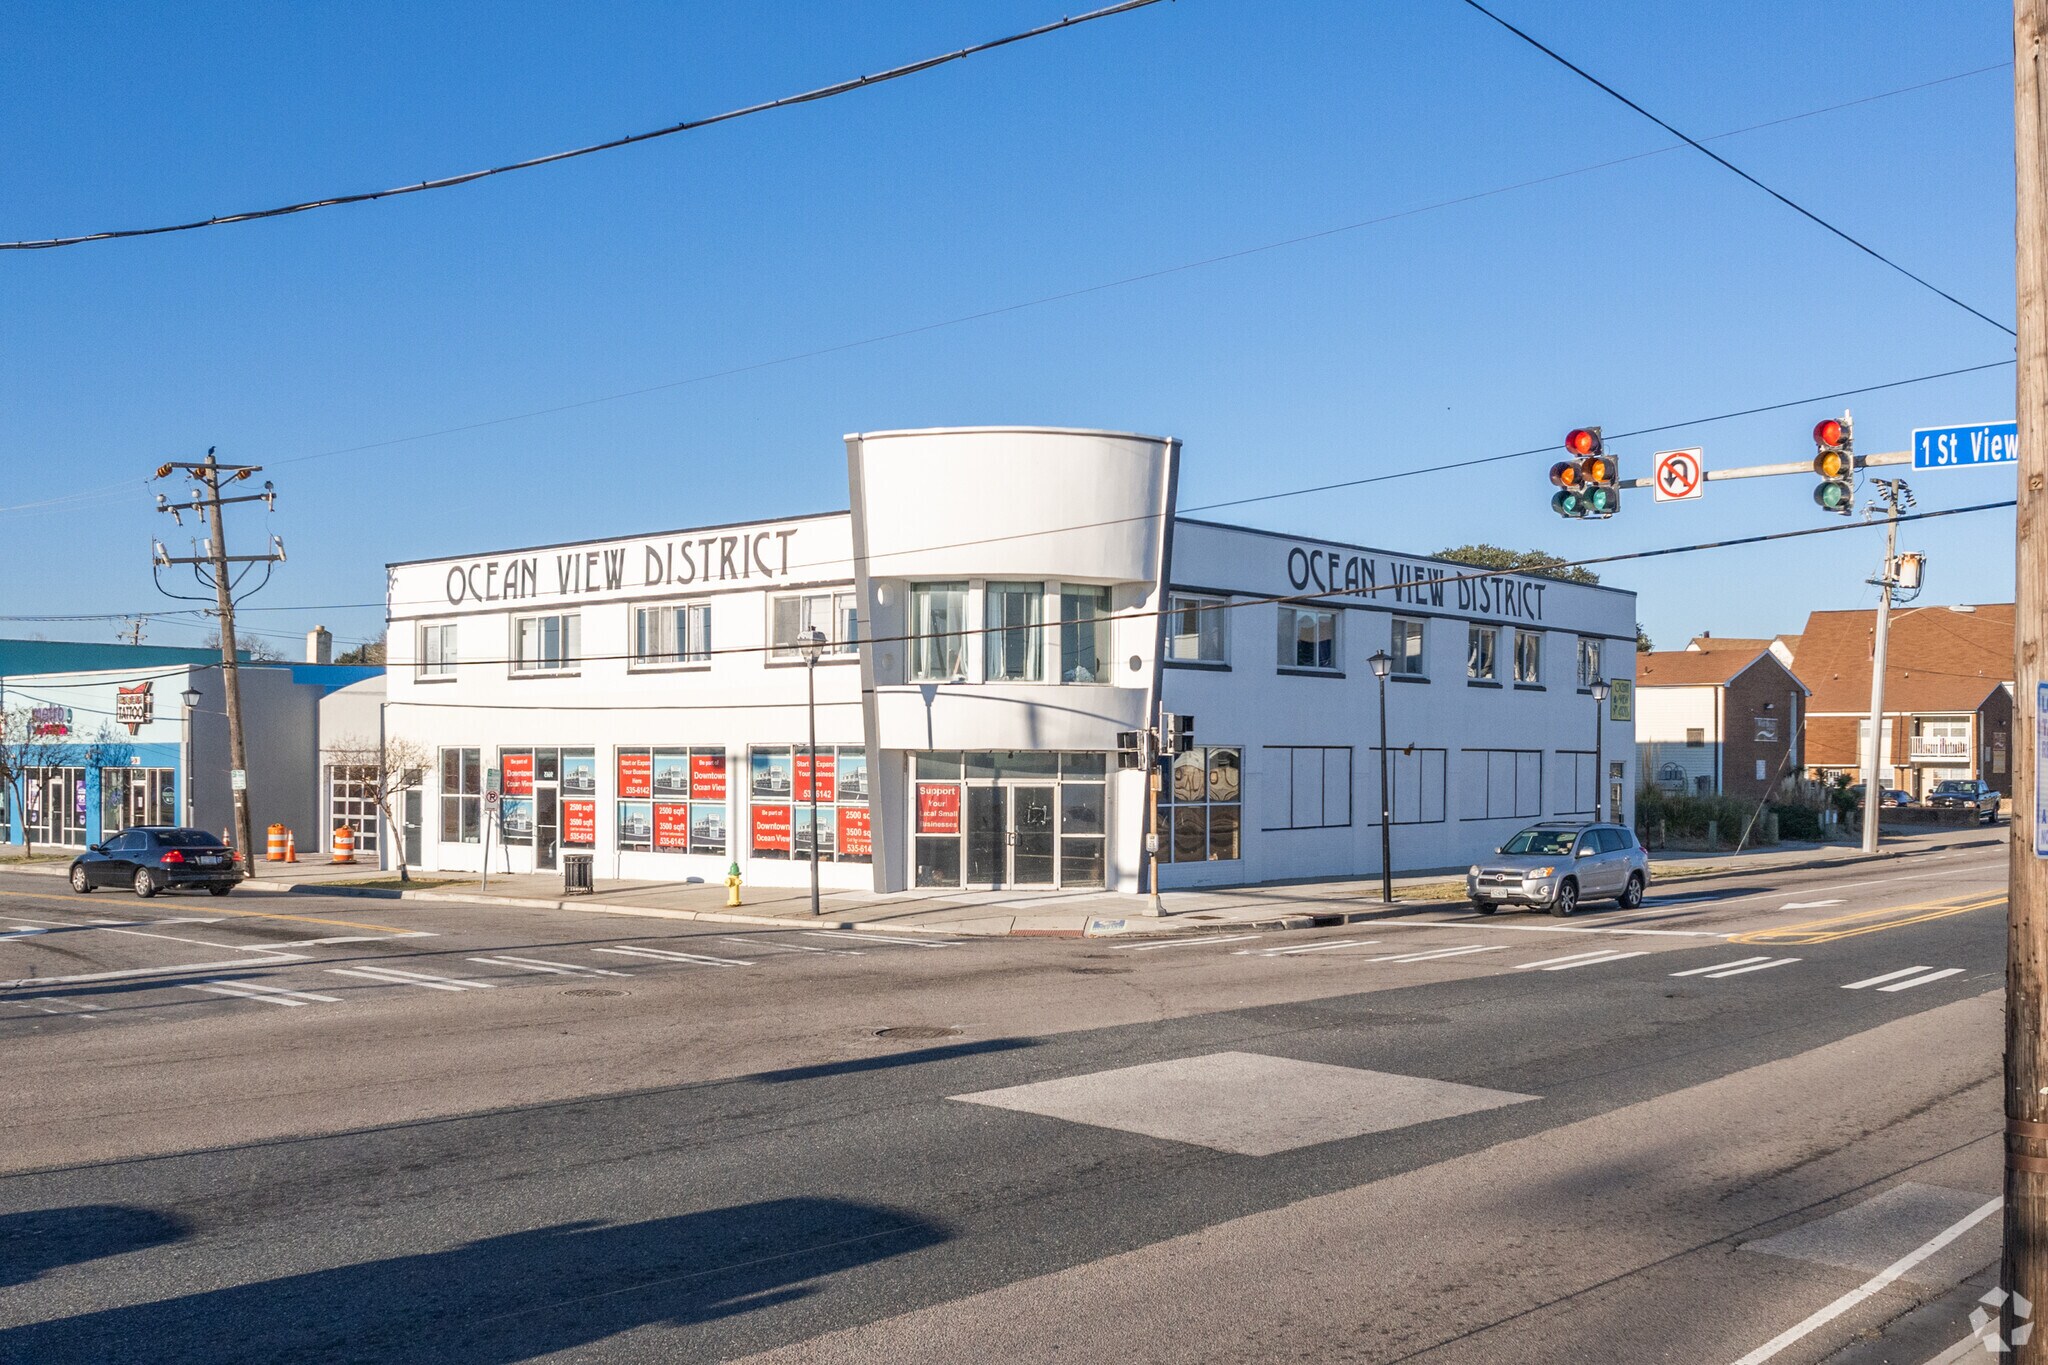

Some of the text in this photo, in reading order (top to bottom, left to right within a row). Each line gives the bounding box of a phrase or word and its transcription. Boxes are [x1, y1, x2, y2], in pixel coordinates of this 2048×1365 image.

[1922, 427, 2018, 466] 1 St View
[446, 528, 799, 606] OCEAN VIEW DISTRICT
[1288, 547, 1547, 621] OCEAN VIEW DISTRICT
[118, 706, 143, 720] TATTOO
[796, 760, 810, 768] Start
[693, 771, 726, 780] Downtown
[626, 786, 650, 794] 535-6142
[712, 783, 726, 791] View
[920, 786, 956, 796] Support
[569, 803, 593, 812] 2500 sqft
[659, 806, 685, 816] 2500 sqft
[845, 811, 861, 820] 2500
[569, 818, 593, 827] 3500 sqft
[659, 822, 685, 832] 3500 sqft
[756, 821, 790, 831] Downtown
[569, 832, 593, 841] 535-6142
[846, 827, 862, 837] 3500
[660, 837, 685, 846] 535-6142
[756, 833, 791, 843] Ocean View
[847, 844, 872, 853] 535-614
